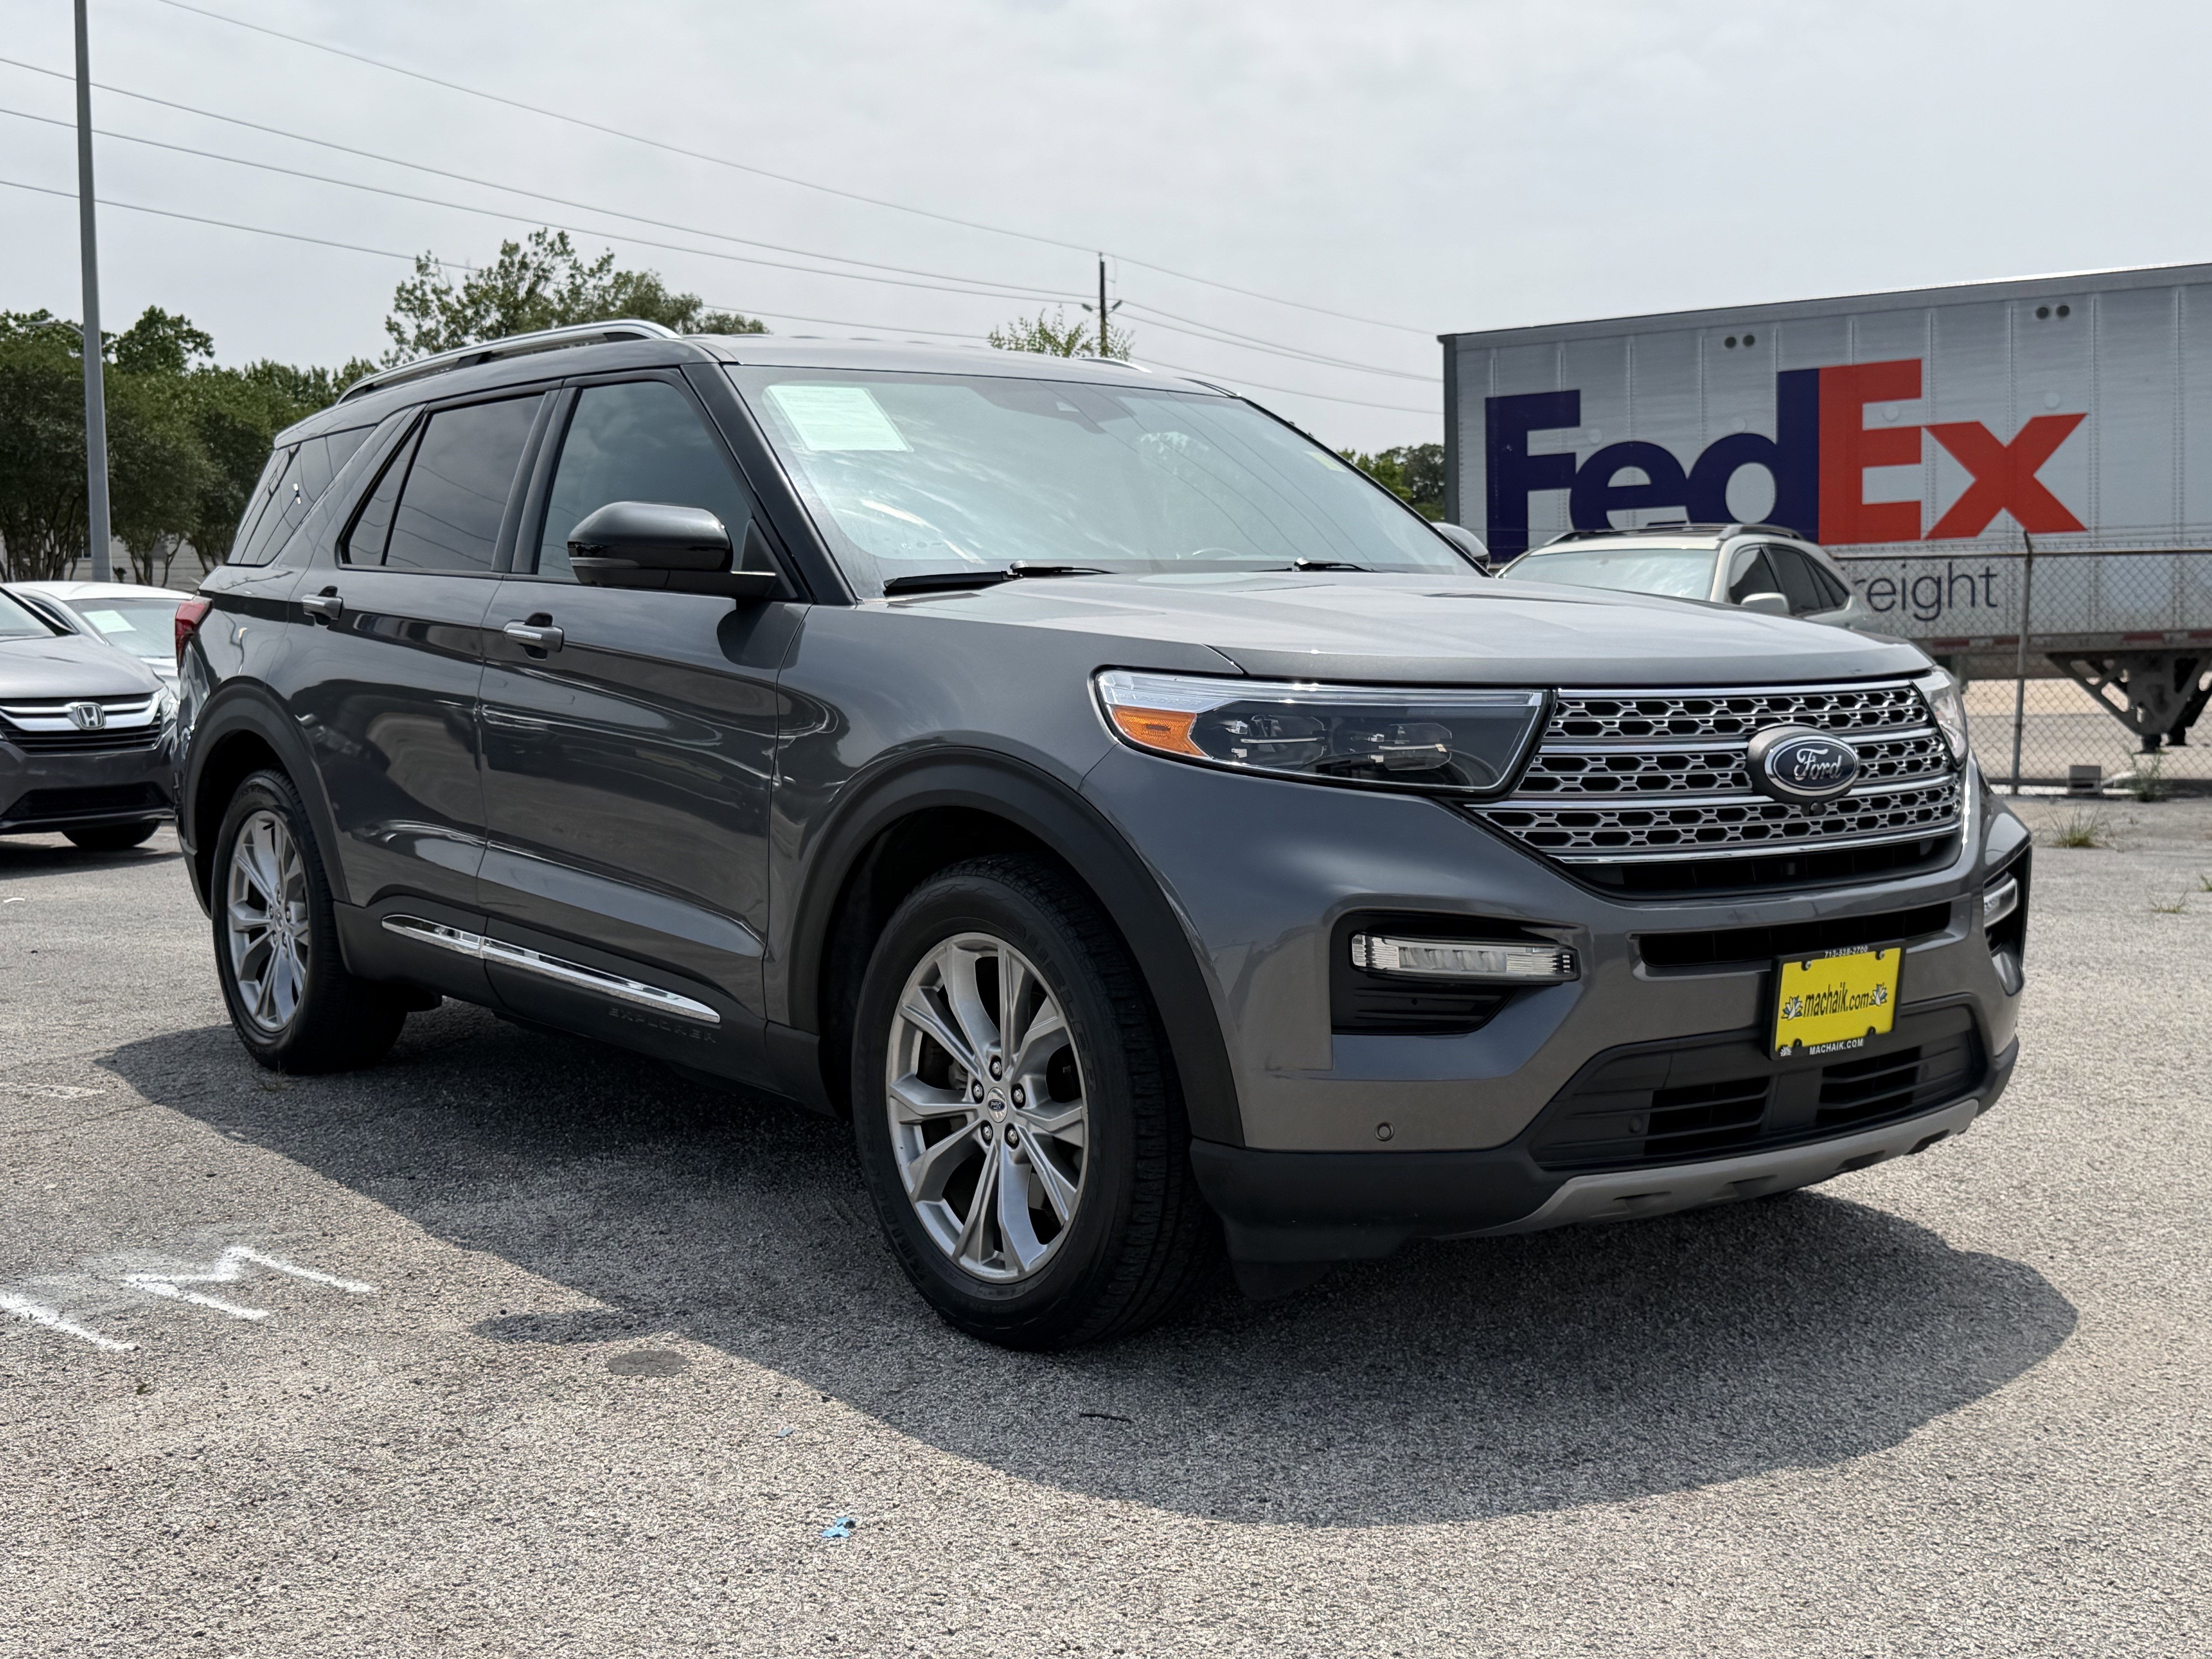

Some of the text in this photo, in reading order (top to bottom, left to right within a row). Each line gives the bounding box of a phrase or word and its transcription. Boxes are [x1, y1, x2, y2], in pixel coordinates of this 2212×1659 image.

[1486, 359, 2088, 562] FedEx
[1848, 562, 1998, 622] eight
[1794, 748, 1843, 781] Ford
[1803, 982, 1870, 1018] machaik.com
[1809, 1037, 1863, 1055] MACHAIK.COM
